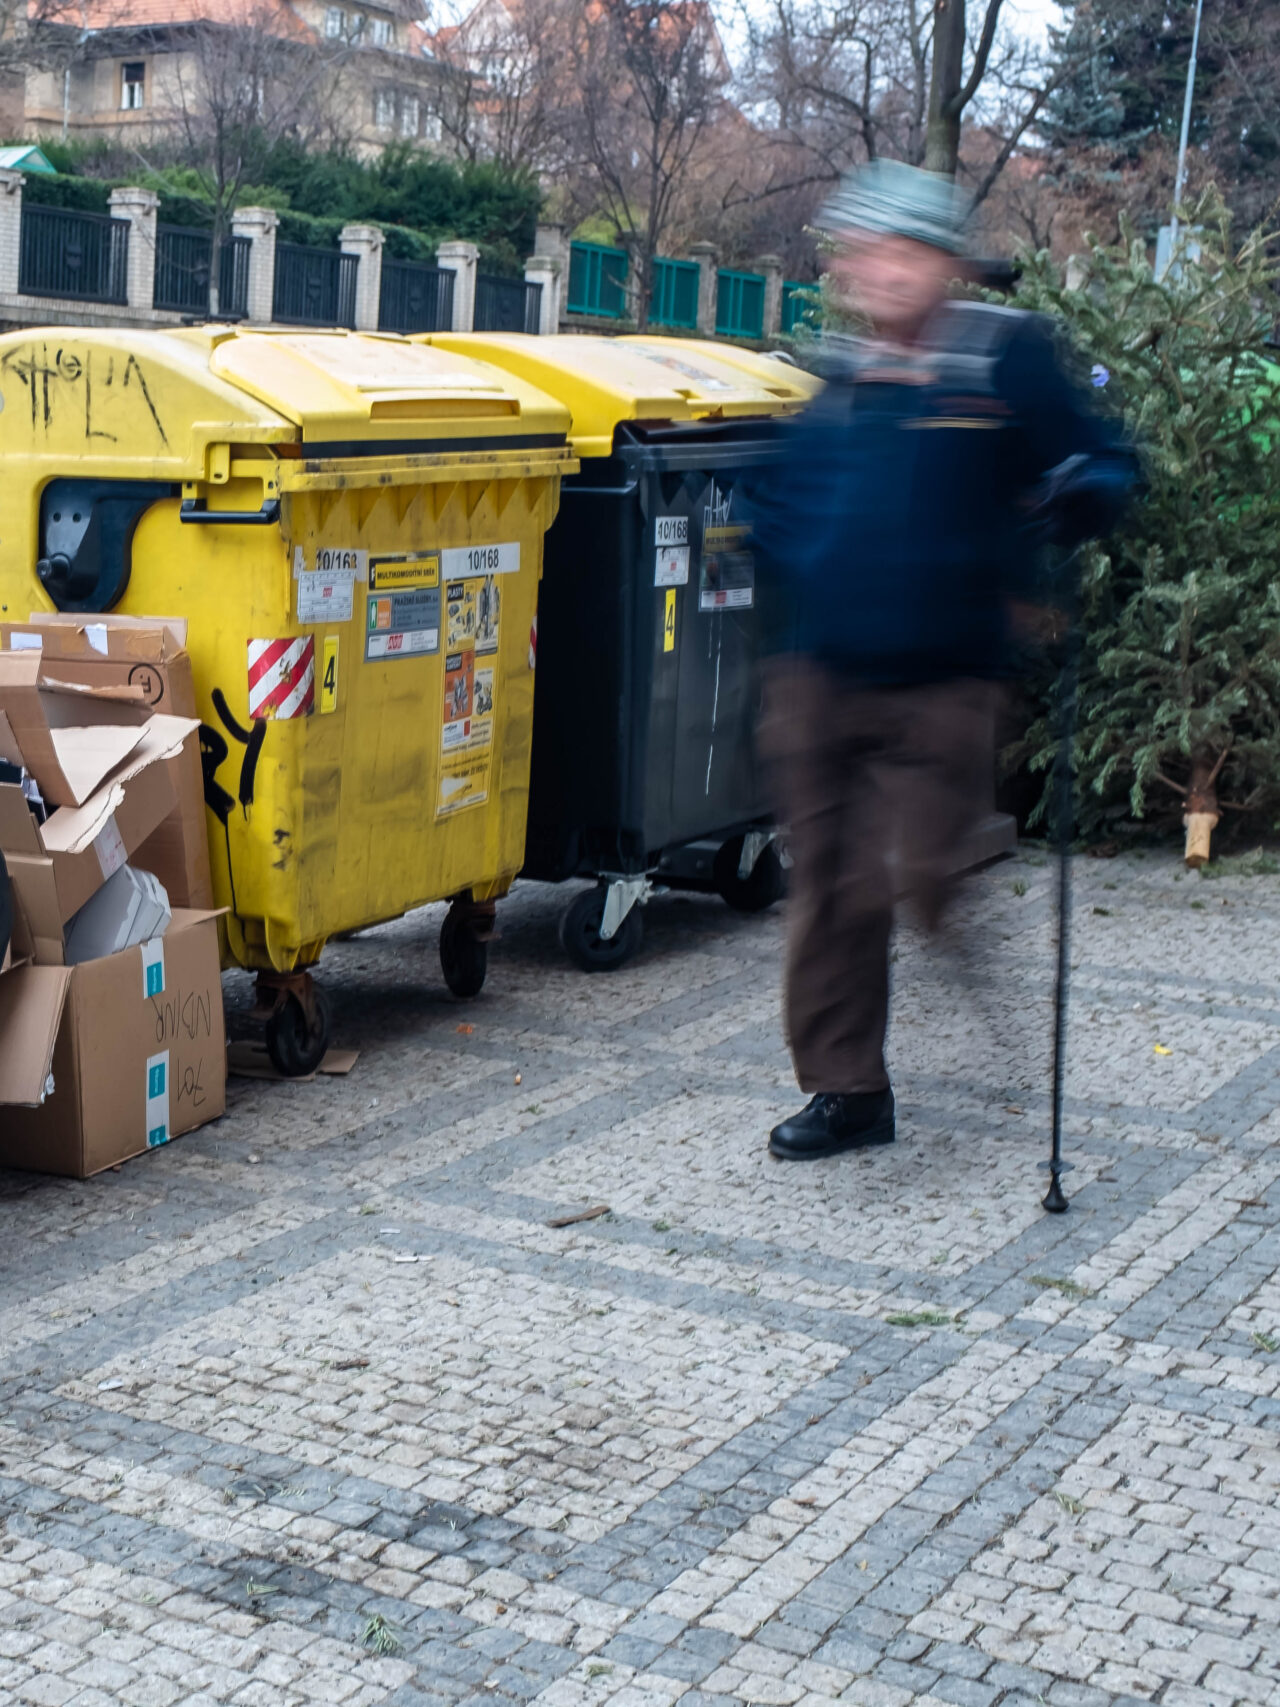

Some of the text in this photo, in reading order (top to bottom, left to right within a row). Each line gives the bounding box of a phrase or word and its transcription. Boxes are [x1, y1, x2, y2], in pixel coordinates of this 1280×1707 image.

[468, 548, 499, 570] 10/168
[666, 604, 674, 636] 4
[323, 656, 335, 695] 4
